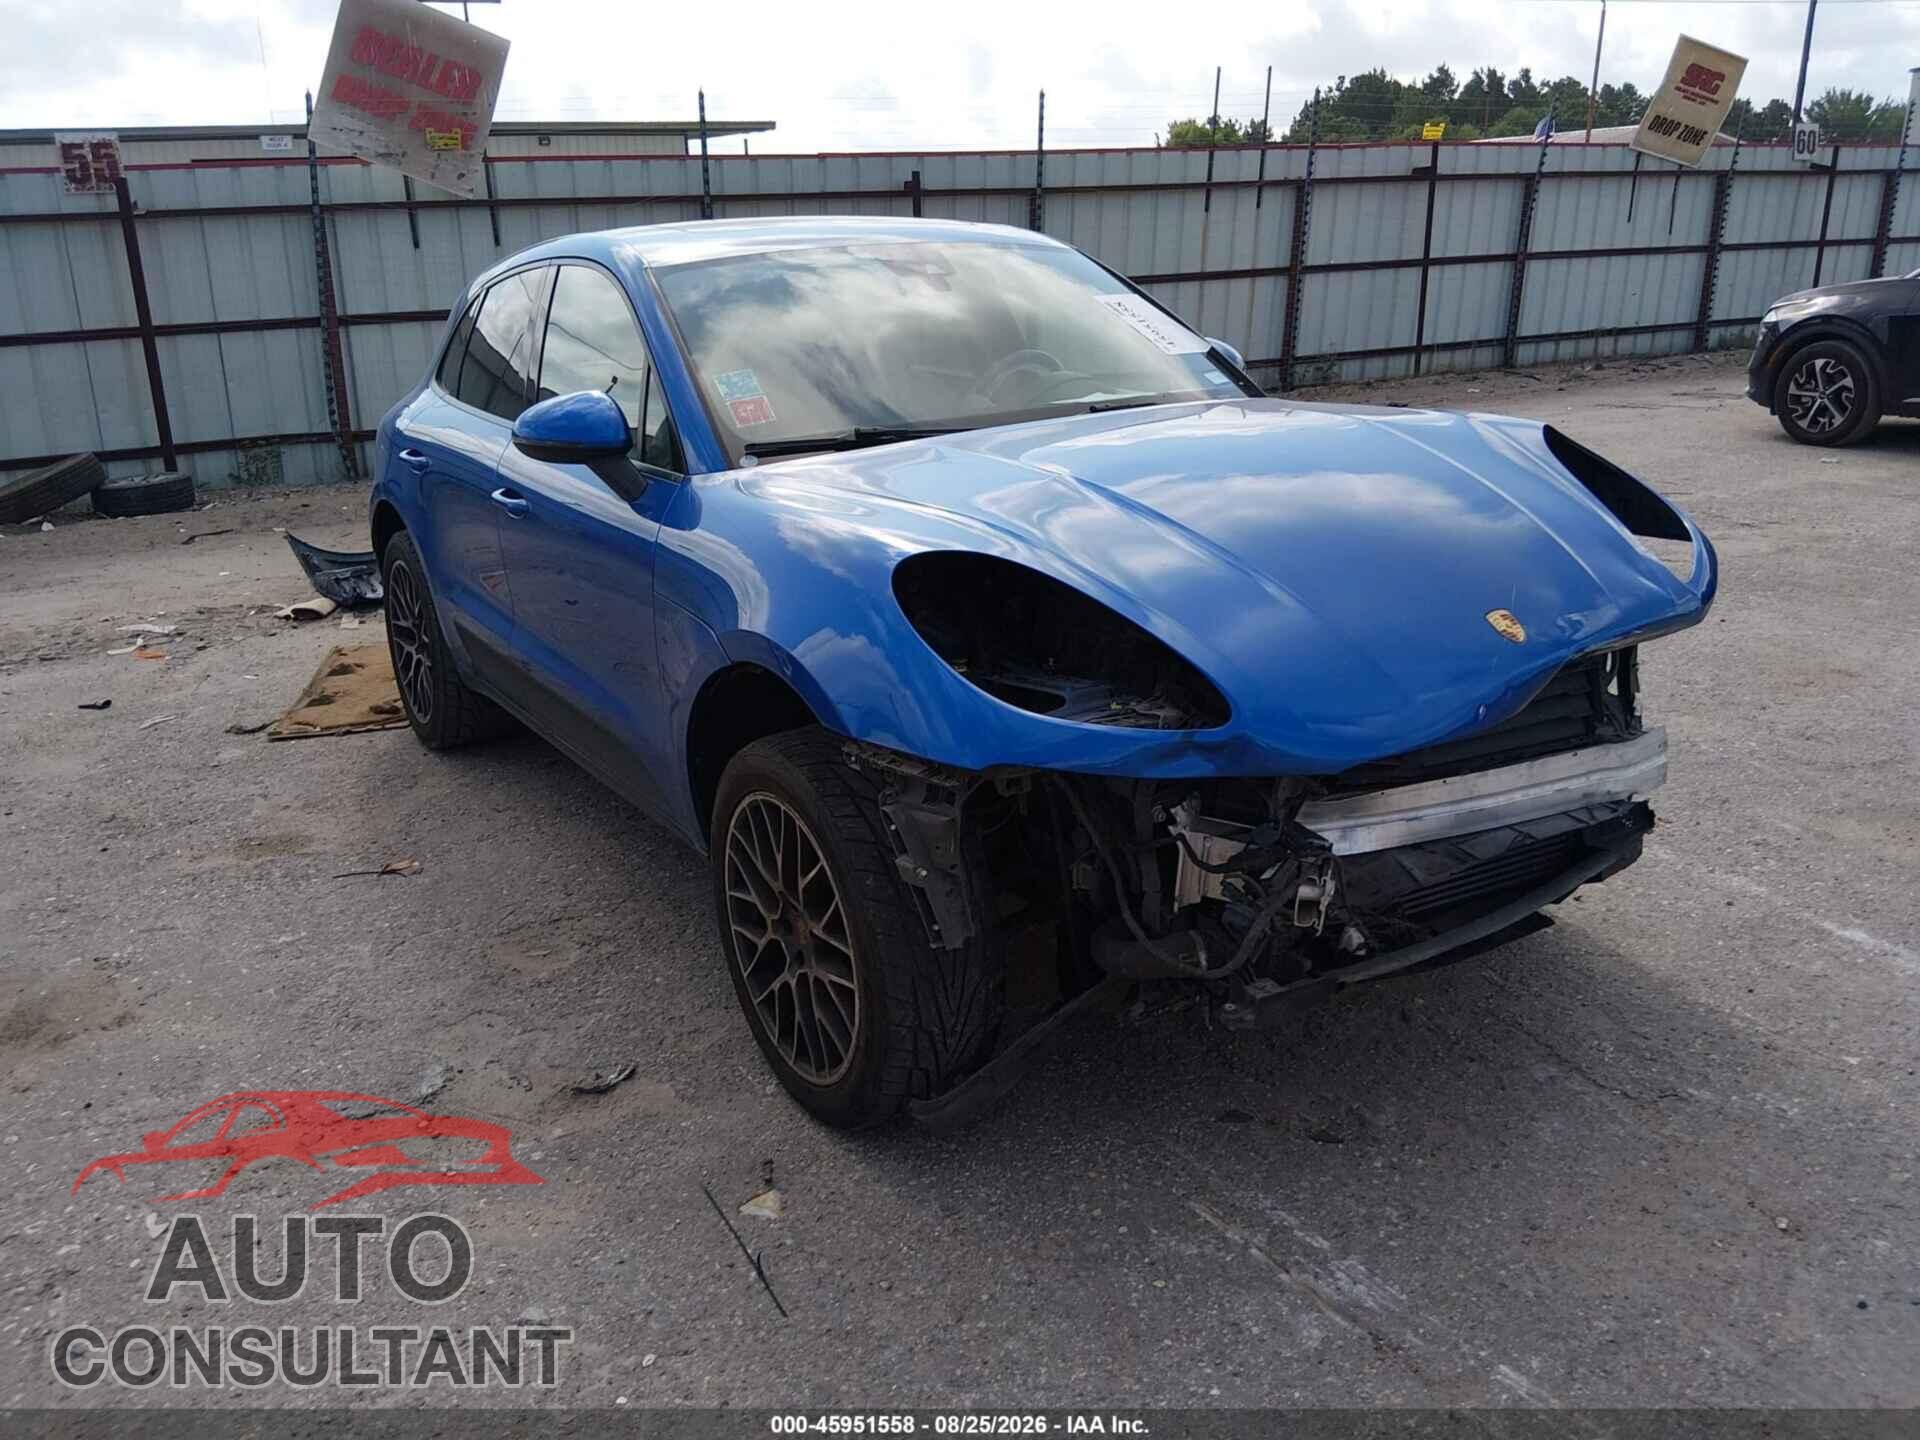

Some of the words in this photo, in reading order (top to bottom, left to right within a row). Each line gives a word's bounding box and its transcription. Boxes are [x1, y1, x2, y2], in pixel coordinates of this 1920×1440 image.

[351, 26, 482, 102] DEALER
[332, 73, 410, 121] DROP
[1648, 115, 1681, 137] DROP
[1676, 123, 1709, 147] ZONE
[1796, 129, 1817, 155] 60
[61, 142, 119, 184] 55
